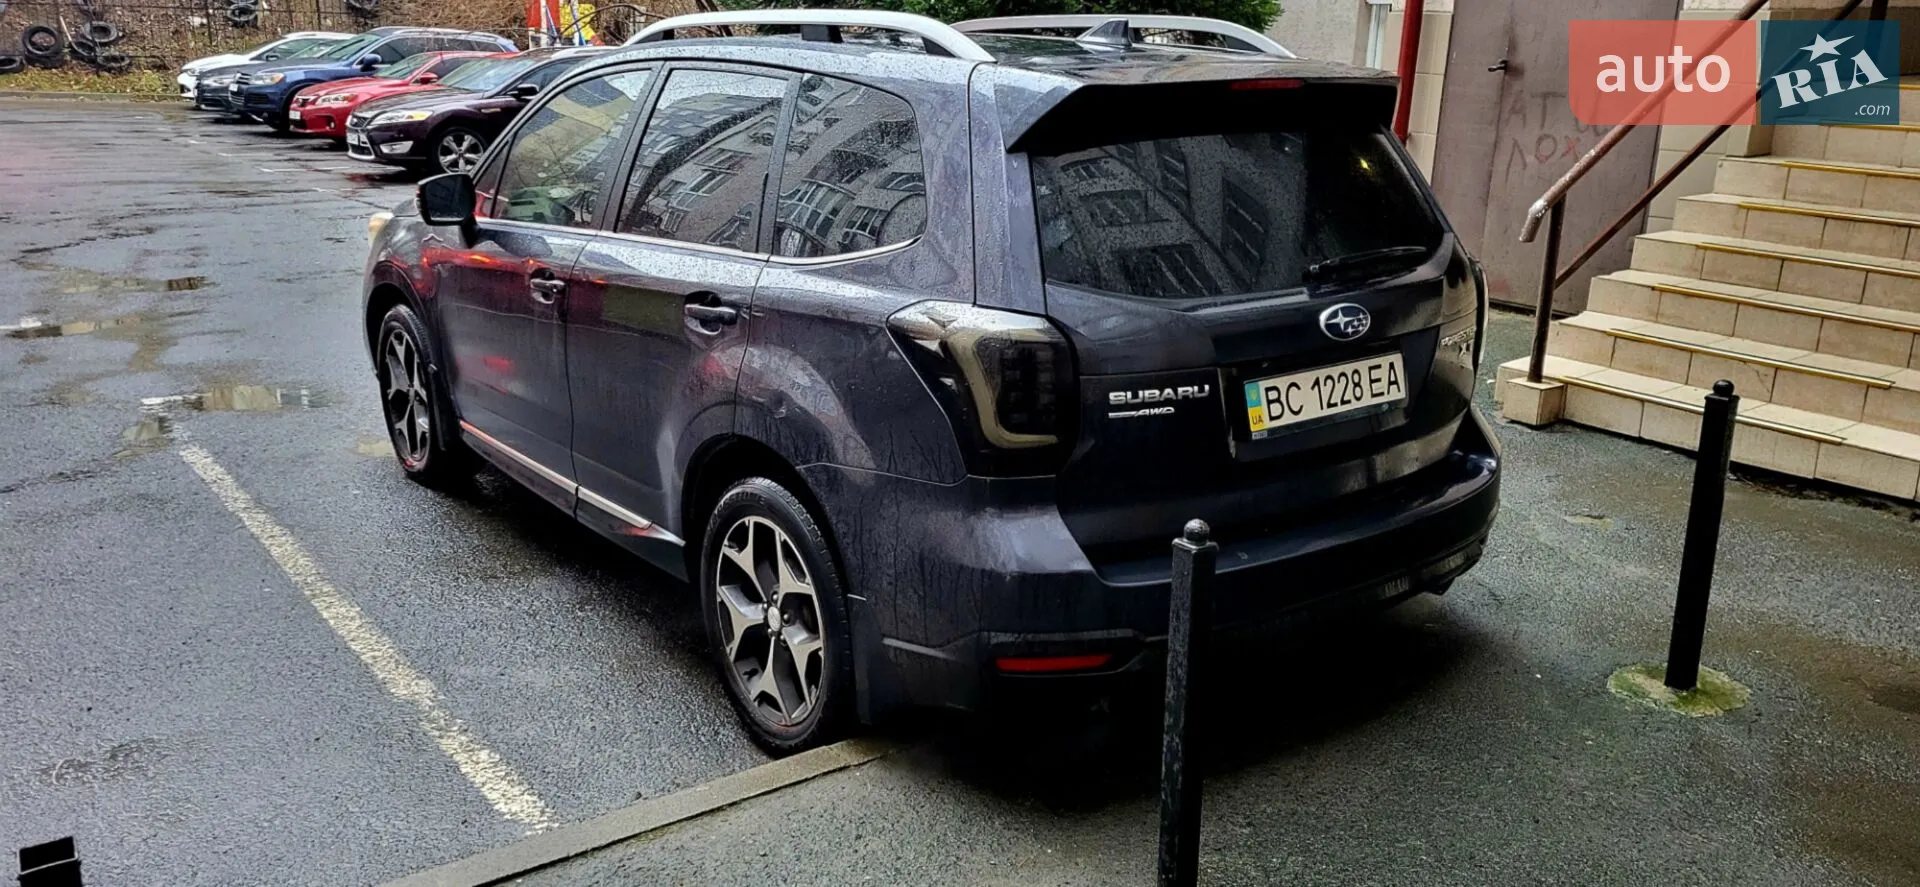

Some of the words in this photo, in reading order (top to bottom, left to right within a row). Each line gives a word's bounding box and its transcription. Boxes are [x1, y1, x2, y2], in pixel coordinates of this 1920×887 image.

[1108, 384, 1210, 405] SUBARU
[1264, 381, 1304, 423] BC
[1310, 368, 1364, 411] 1228
[1367, 361, 1402, 399] EA
[1130, 406, 1176, 417] AWD
[1252, 415, 1264, 425] UA
